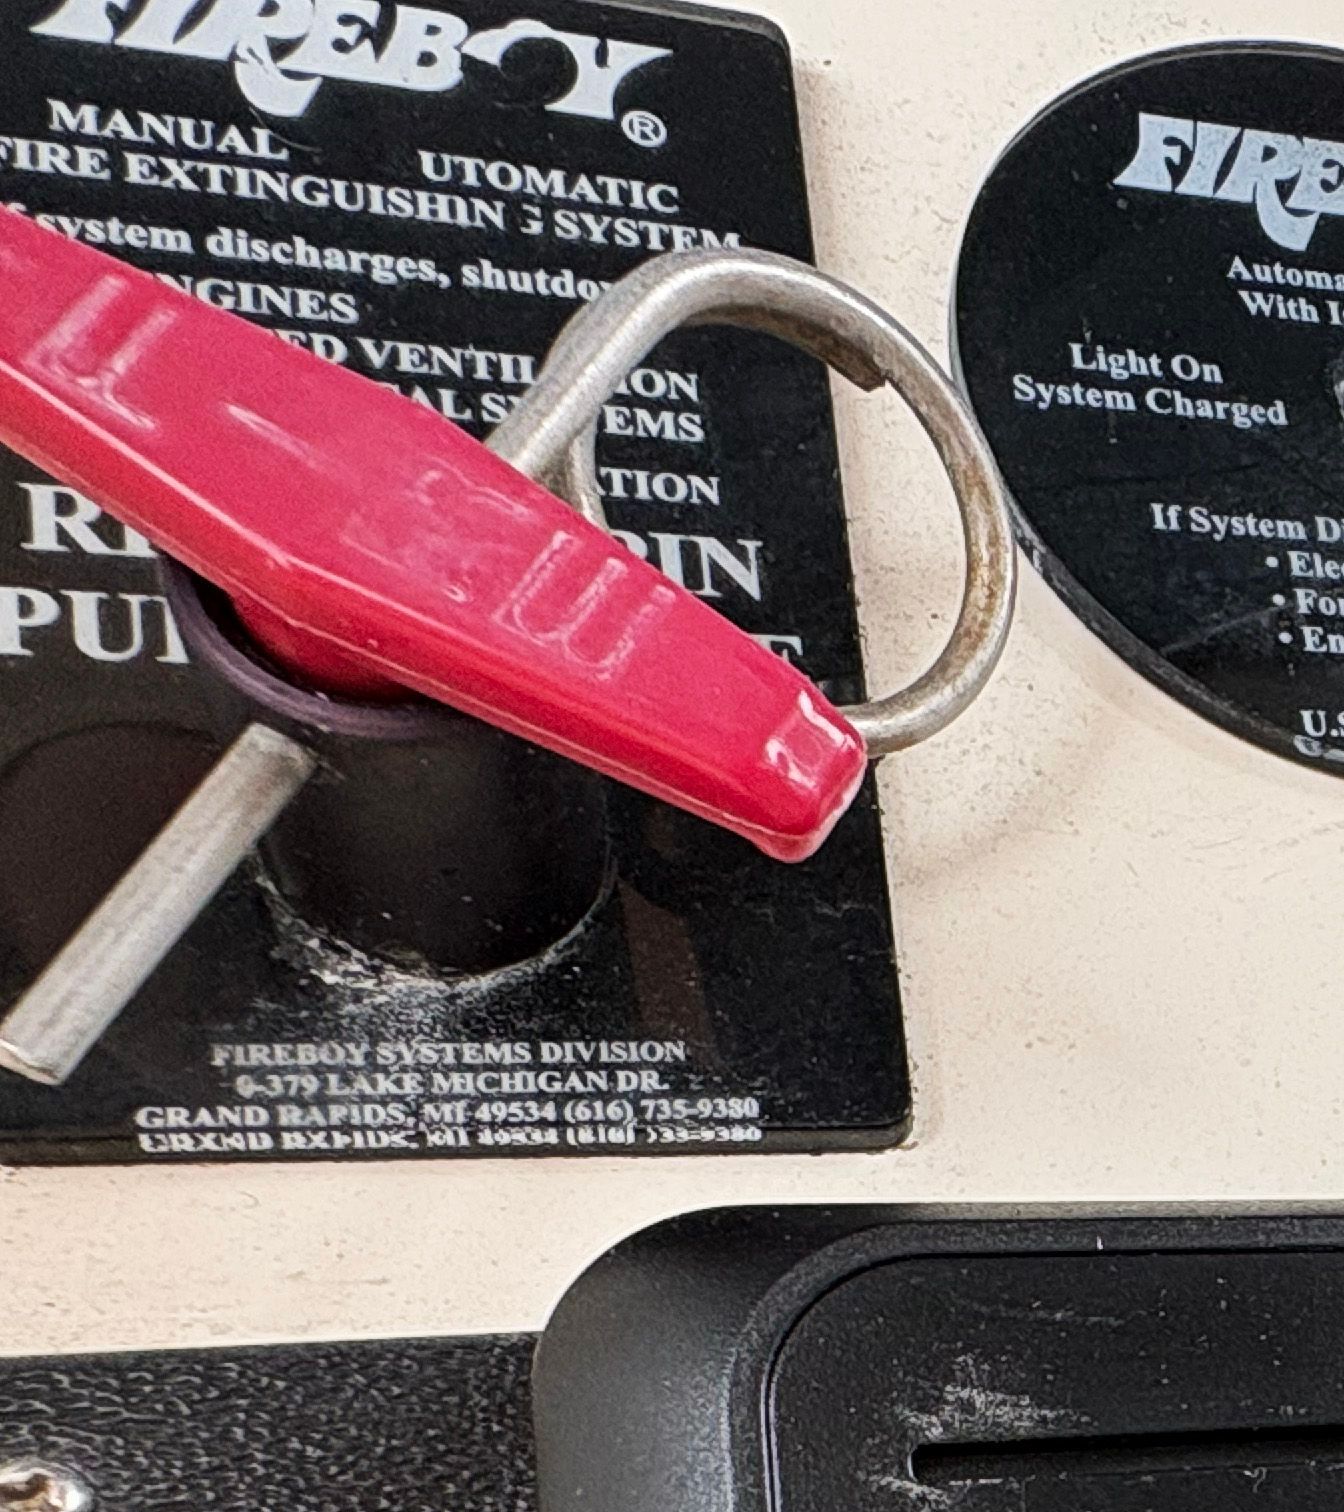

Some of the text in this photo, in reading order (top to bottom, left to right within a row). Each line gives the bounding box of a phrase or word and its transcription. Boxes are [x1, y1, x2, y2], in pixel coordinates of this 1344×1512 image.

[46, 98, 290, 161] MANUAL
[206, 226, 450, 289] discharges,
[1237, 291, 1320, 324] With
[1069, 342, 1223, 384] Light On
[1012, 374, 1288, 428] System Charged
[1150, 504, 1180, 531] If
[1189, 507, 1308, 541] System
[210, 1040, 686, 1066] FIREBOY SYSTEMS DIVISION
[325, 1072, 424, 1096] LAKE
[430, 1070, 608, 1096] MICHIGAN
[133, 1105, 270, 1128] GRAND
[474, 1100, 557, 1122] 49534
[564, 1099, 634, 1124] (616)
